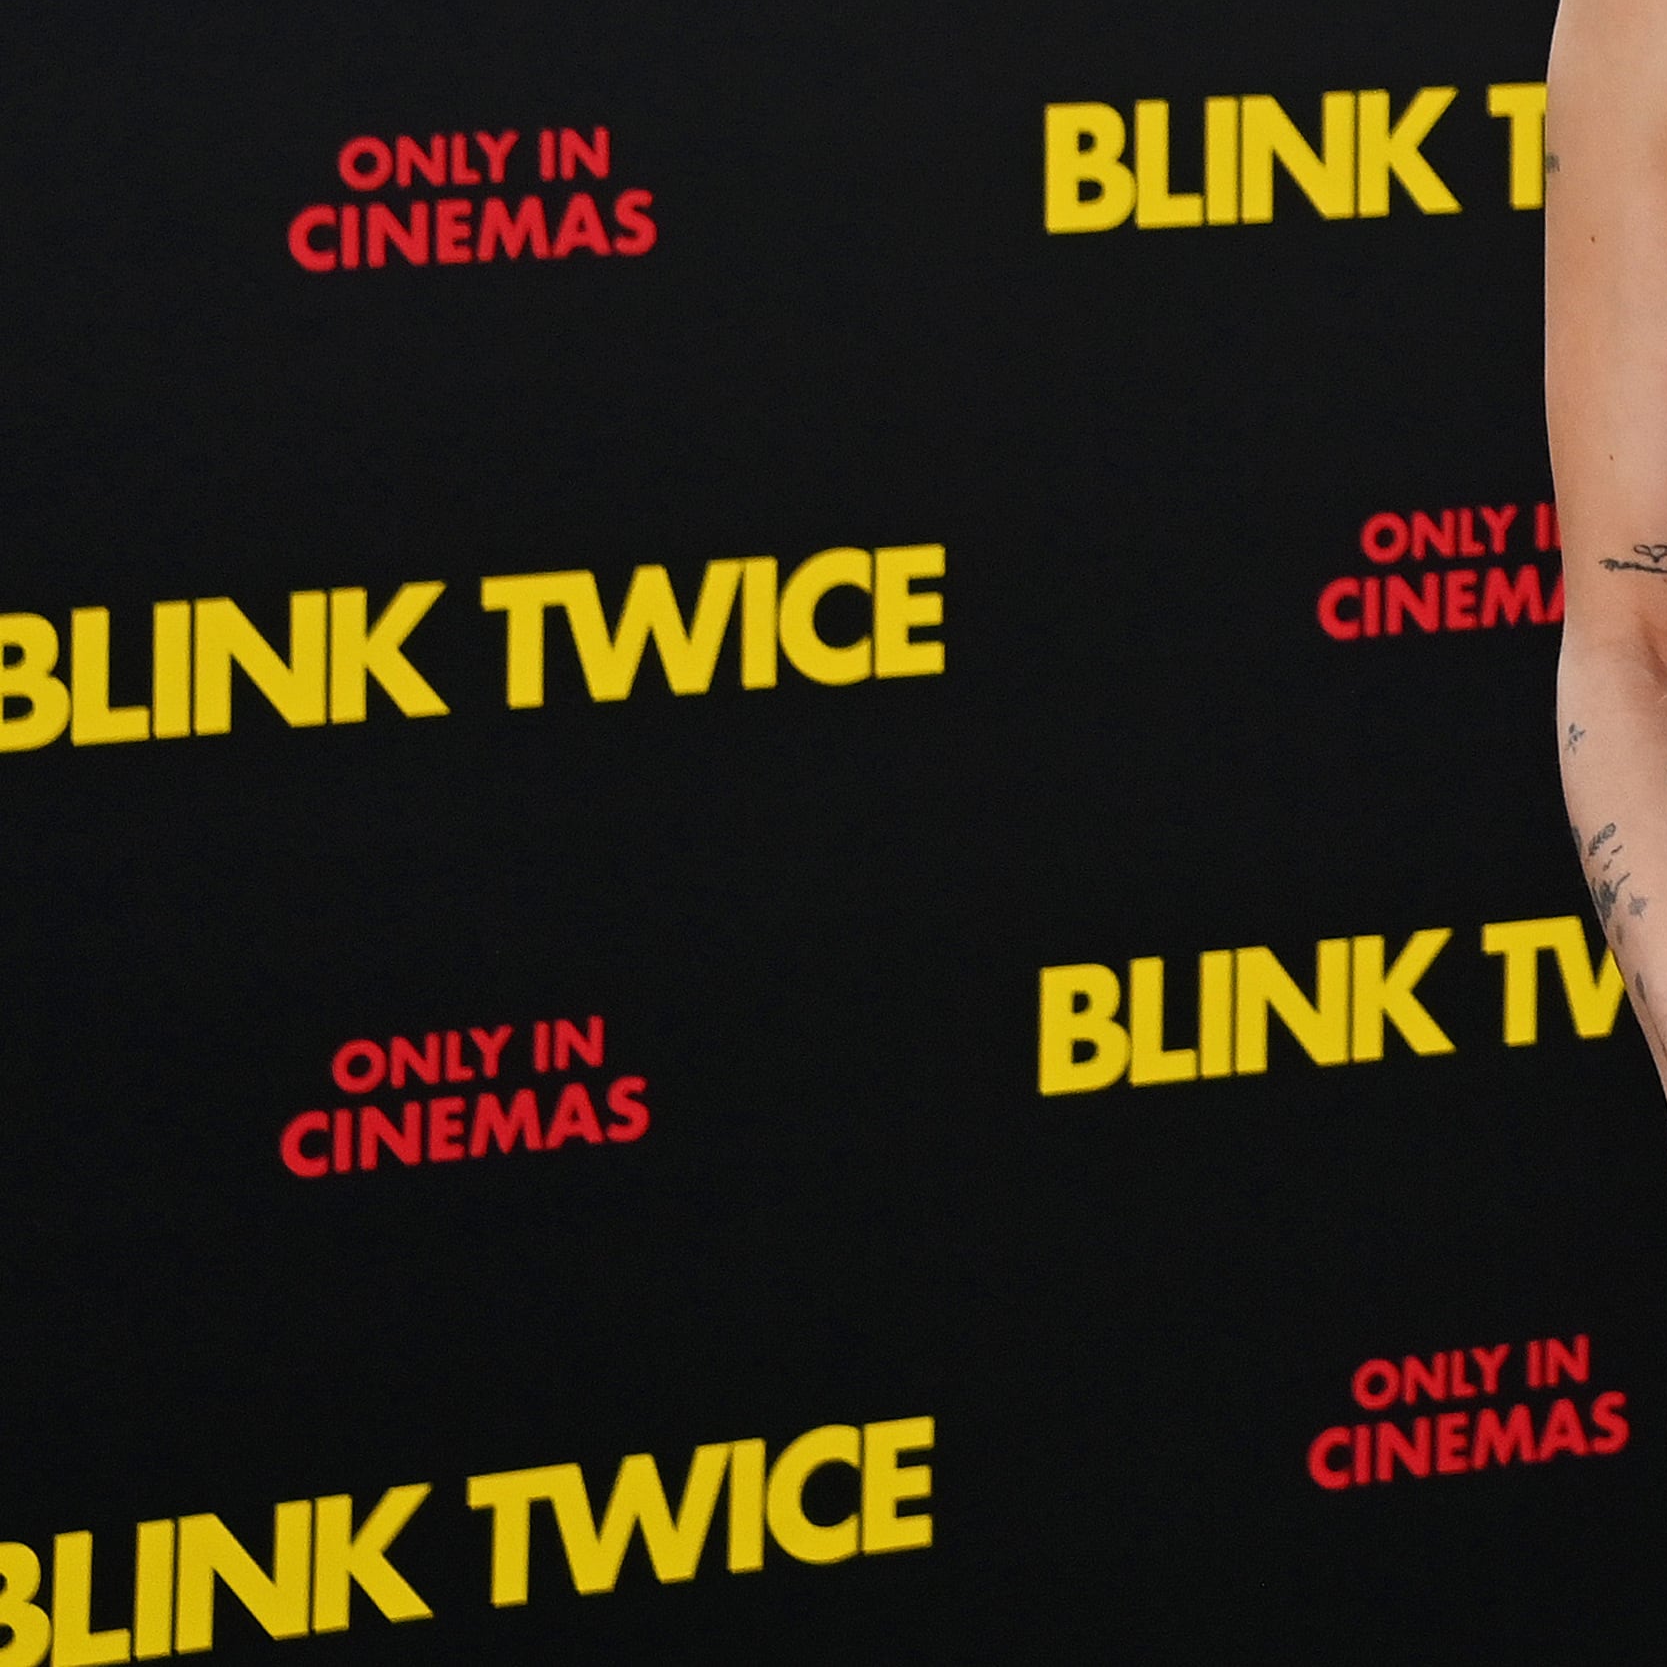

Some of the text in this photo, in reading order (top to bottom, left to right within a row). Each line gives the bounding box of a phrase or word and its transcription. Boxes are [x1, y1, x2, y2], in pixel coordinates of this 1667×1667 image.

[337, 126, 611, 192] ONLY IN
[1043, 85, 1461, 235] BLINK
[286, 188, 659, 273] CINEMAS
[1359, 501, 1562, 564] ONLY I
[0, 543, 947, 753] BLINK TWICE
[1316, 564, 1566, 641] CINEM
[330, 1014, 606, 1094] ONLY IN
[1037, 926, 1456, 1097] BLINK
[279, 1076, 652, 1179] CINEMAS
[1351, 1333, 1591, 1411] ONLY IN
[1307, 1390, 1631, 1491] CINEMAS
[466, 1415, 936, 1608] TWICE
